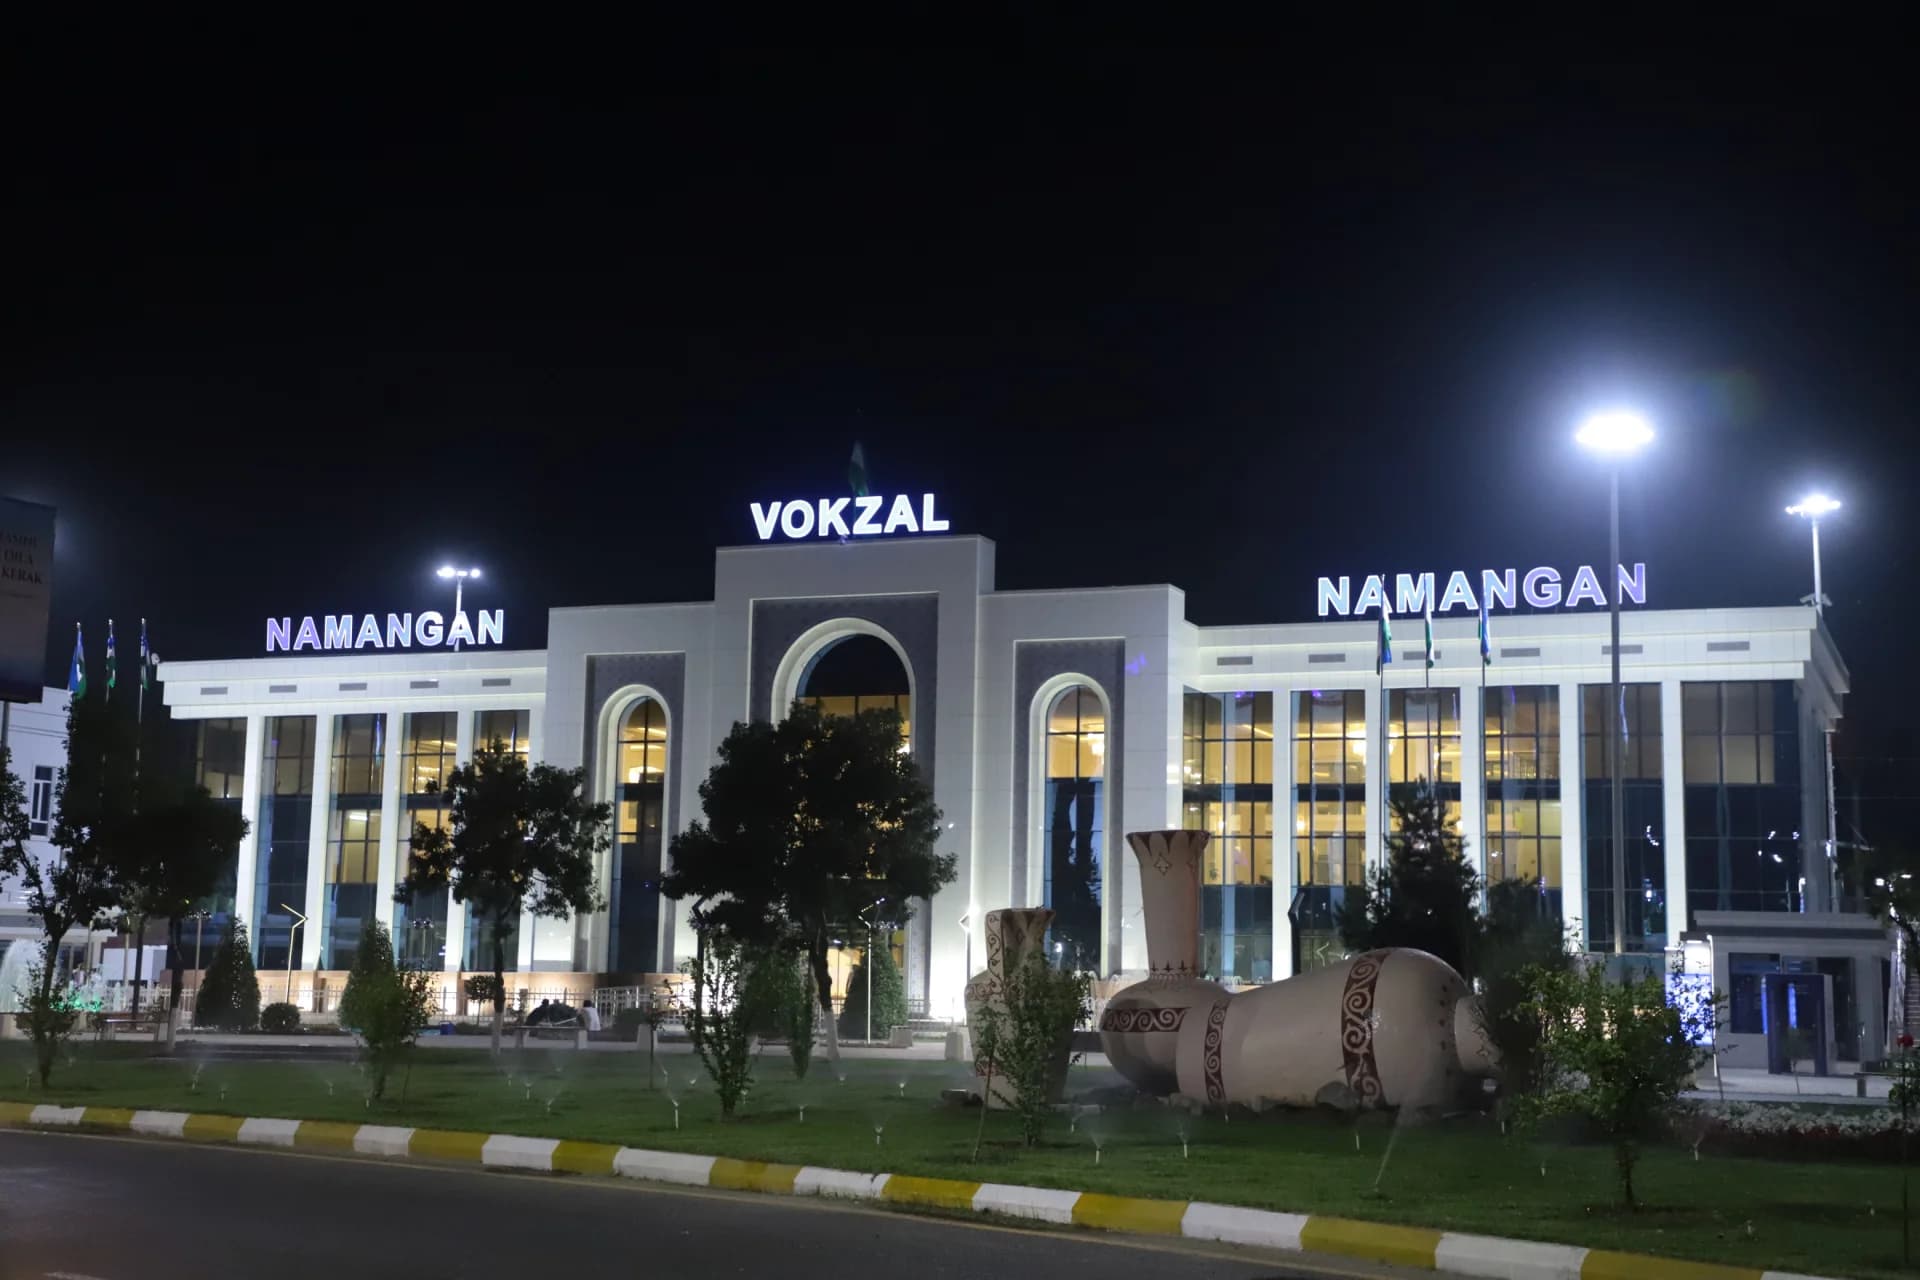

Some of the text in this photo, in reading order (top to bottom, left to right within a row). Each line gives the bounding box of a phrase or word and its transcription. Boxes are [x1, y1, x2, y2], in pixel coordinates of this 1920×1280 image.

[750, 493, 949, 540] VOKZAL
[1318, 563, 1647, 616] NAMANGAN
[266, 609, 504, 651] NAMANGAN
